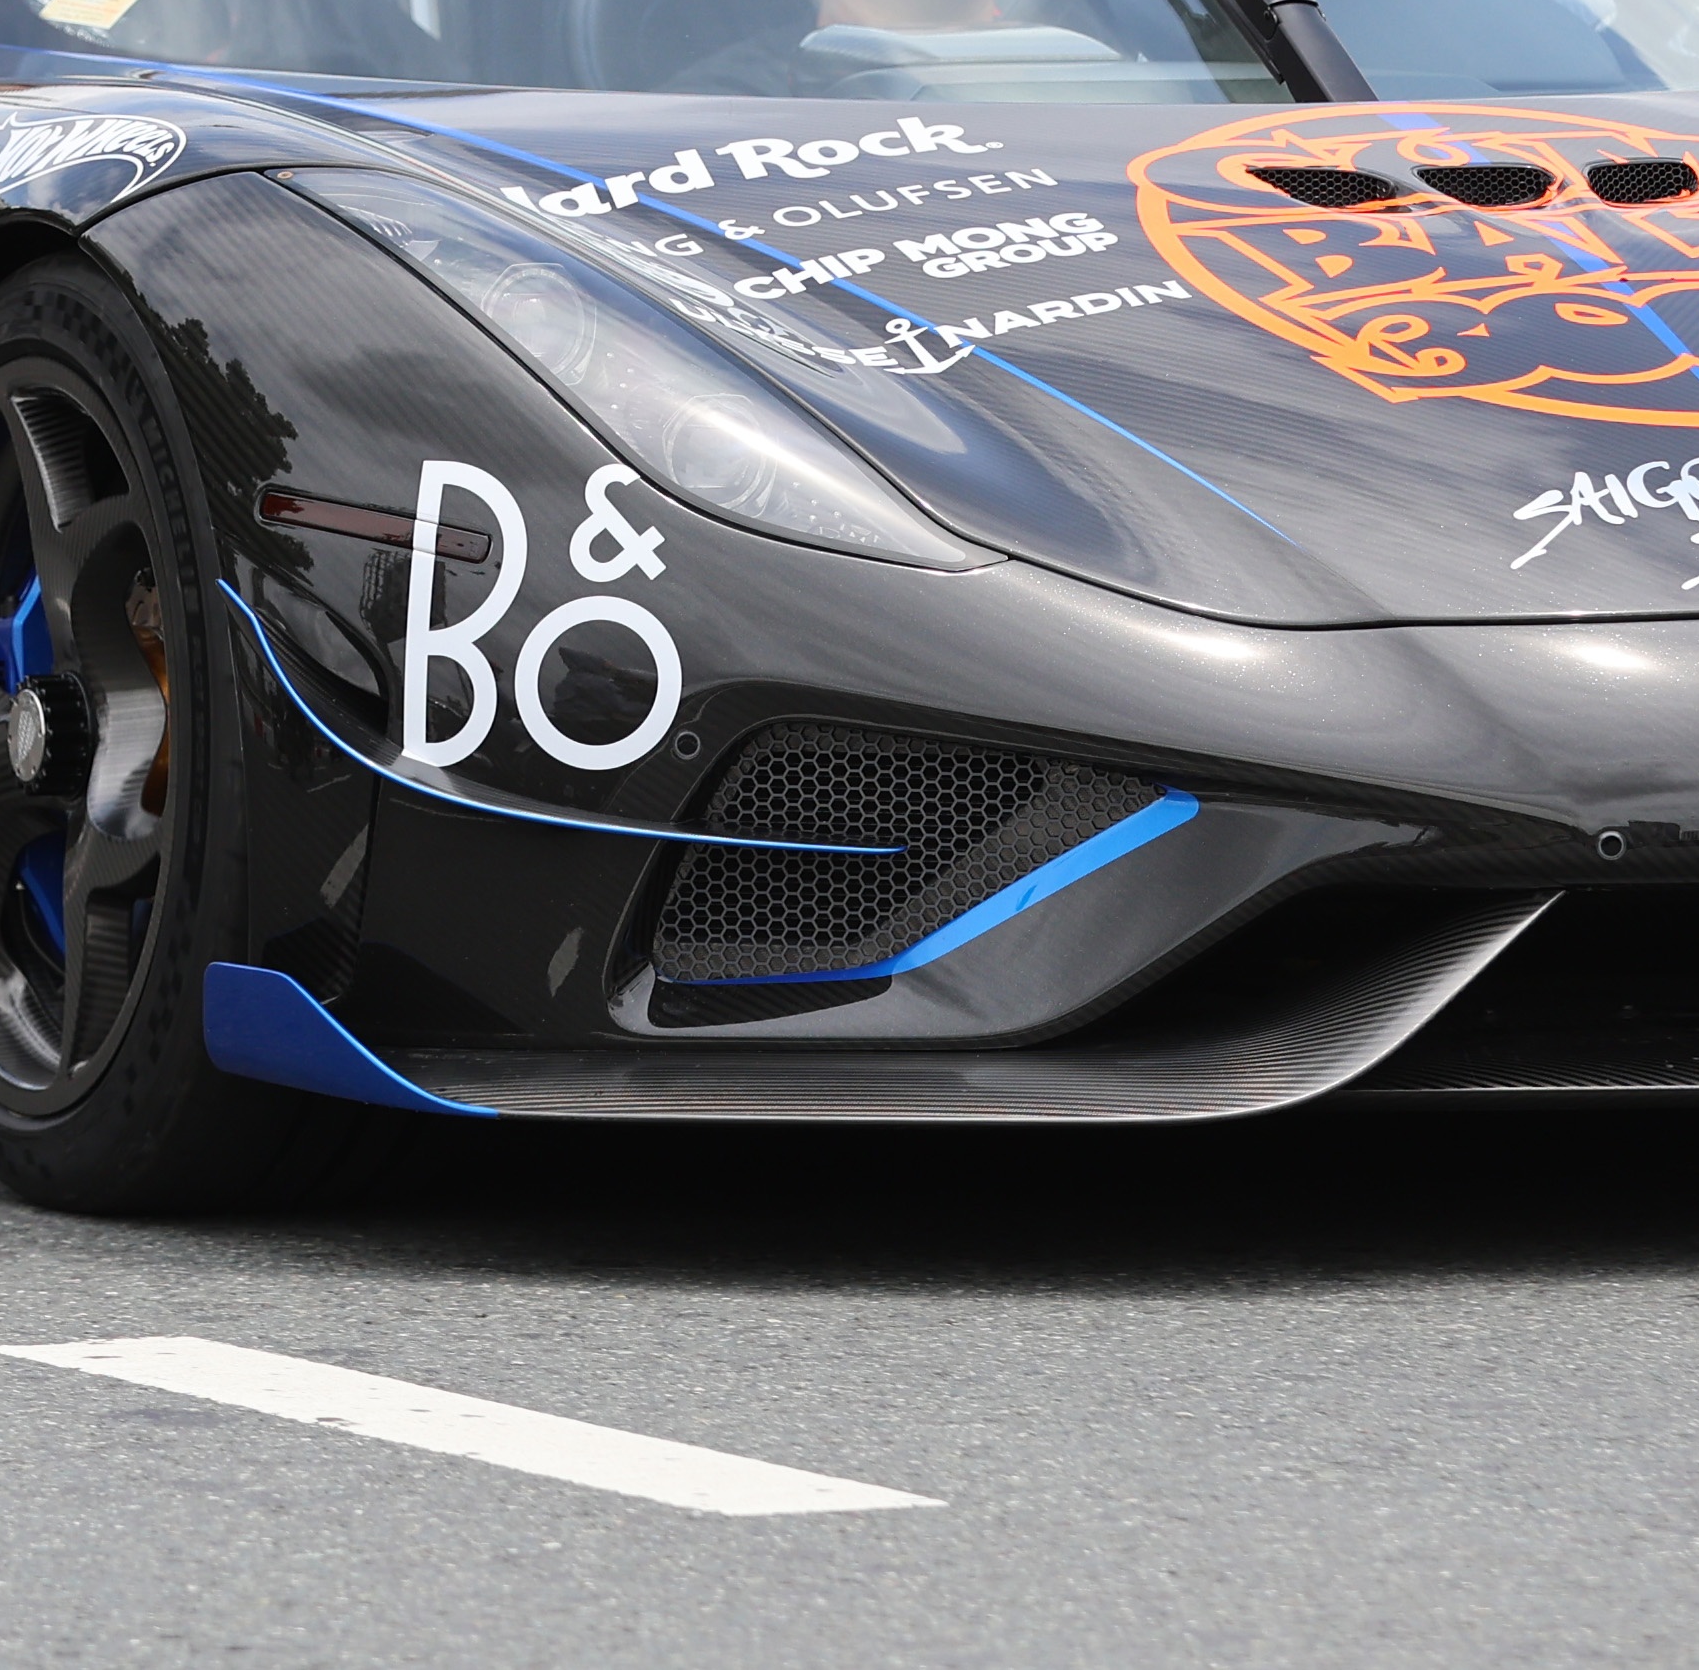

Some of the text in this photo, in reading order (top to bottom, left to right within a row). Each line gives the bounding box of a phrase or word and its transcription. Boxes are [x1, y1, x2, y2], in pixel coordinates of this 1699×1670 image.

[715, 116, 990, 180] Rock
[718, 219, 765, 241] &
[772, 167, 1058, 228] OLUFSEN
[733, 210, 1105, 300] CHIP MONG
[921, 229, 1120, 280] GROUP
[940, 277, 1193, 347] NARDIN
